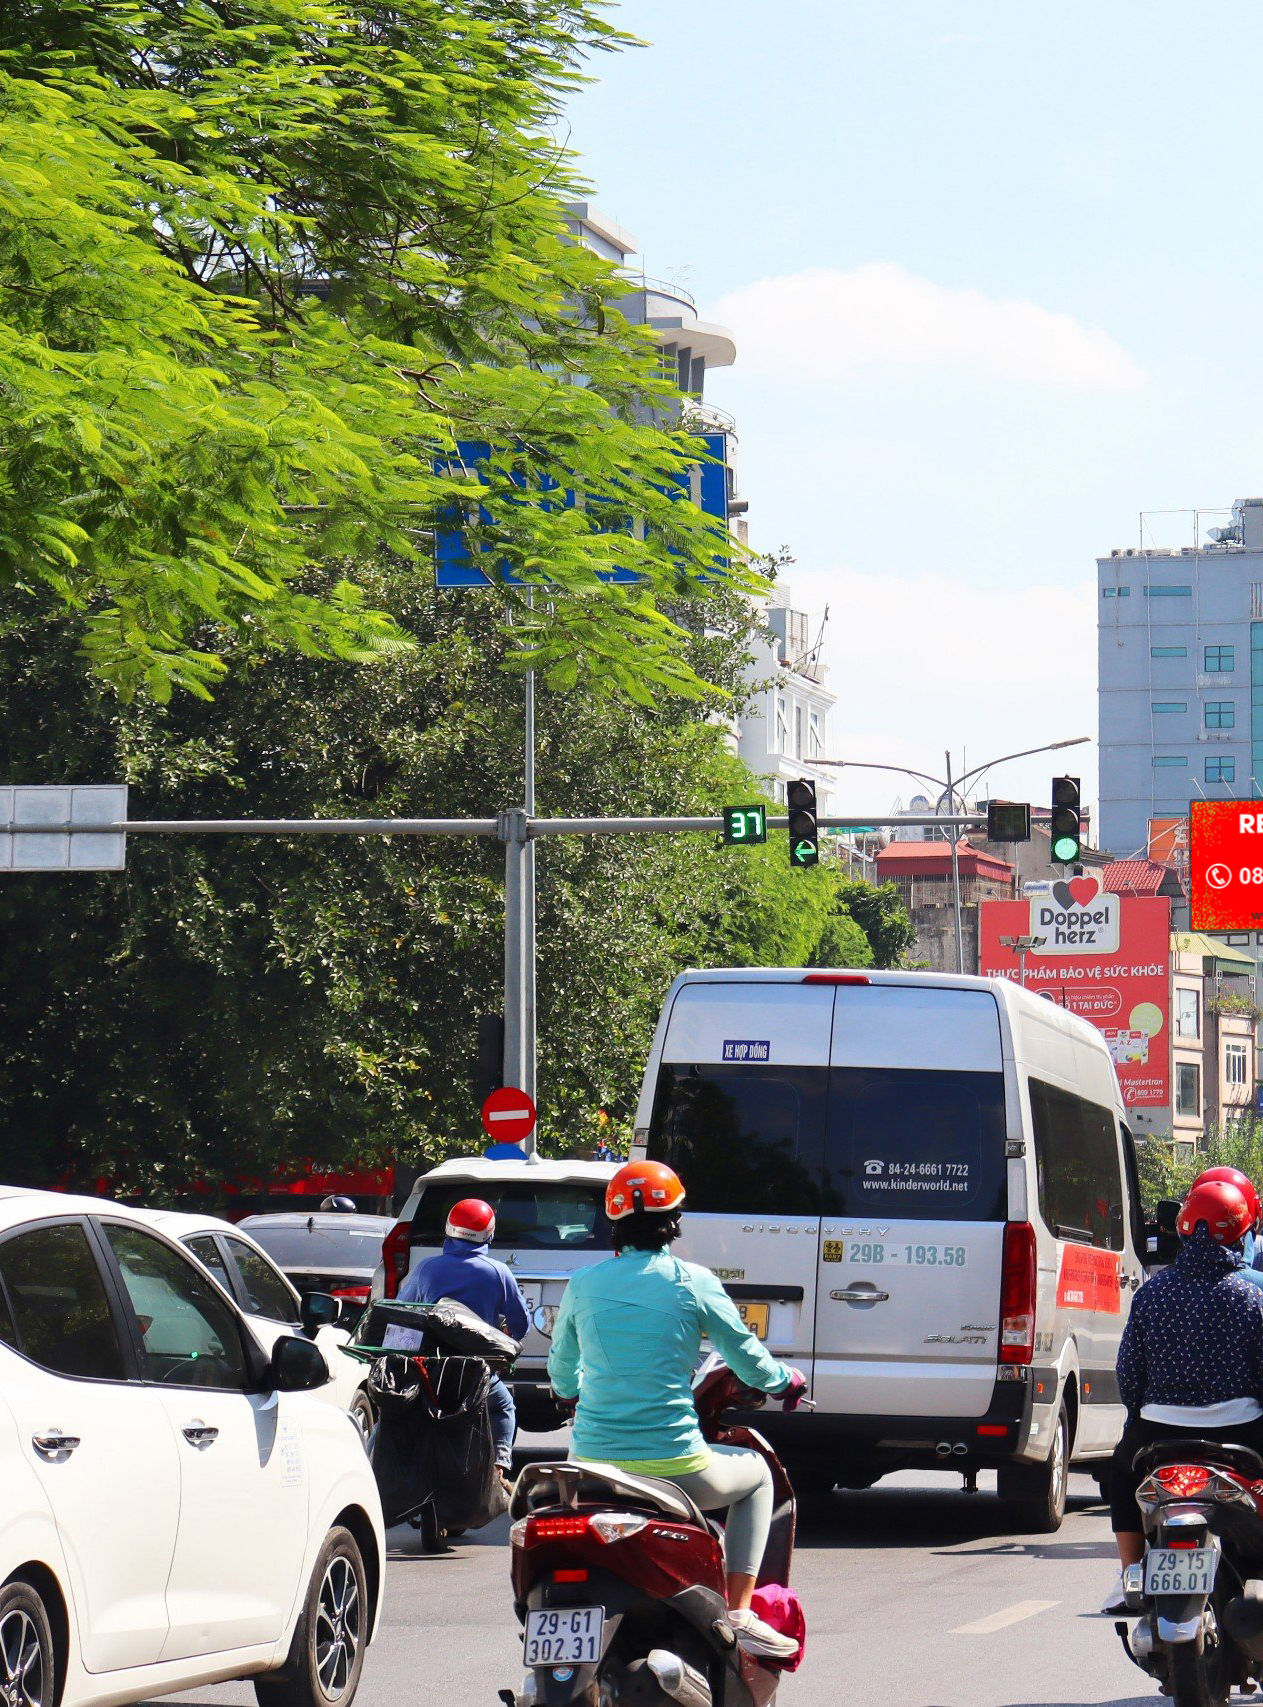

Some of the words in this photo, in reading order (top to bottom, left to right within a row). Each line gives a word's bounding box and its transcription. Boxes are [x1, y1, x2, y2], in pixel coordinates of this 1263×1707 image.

[732, 812, 761, 838] 37
[1040, 907, 1110, 930] Doppel
[1055, 926, 1096, 945] herz
[1022, 966, 1058, 979] PHẨM
[1060, 966, 1084, 978] BẢO
[1086, 966, 1102, 979] VỆ
[1104, 966, 1128, 977] SỨC
[1130, 965, 1164, 976] KHỎE
[1072, 1002, 1077, 1010] 1
[1078, 1002, 1092, 1012] TẠI
[1094, 1000, 1114, 1009] ĐỨC
[724, 1044, 733, 1058] XE
[1124, 1078, 1163, 1086] Mastertran
[888, 1162, 942, 1176] 84-24-6661
[945, 1164, 969, 1176] 7722
[862, 1178, 968, 1192] www.kinderworld.net
[742, 1224, 890, 1236] DISCOVERY
[849, 1244, 884, 1264] 29B
[904, 1246, 966, 1266] 193.58
[1157, 1552, 1205, 1570] 29-Y5
[1150, 1572, 1209, 1591] 666.01
[538, 1610, 591, 1636] 29-G1
[529, 1636, 596, 1664] 302.31
